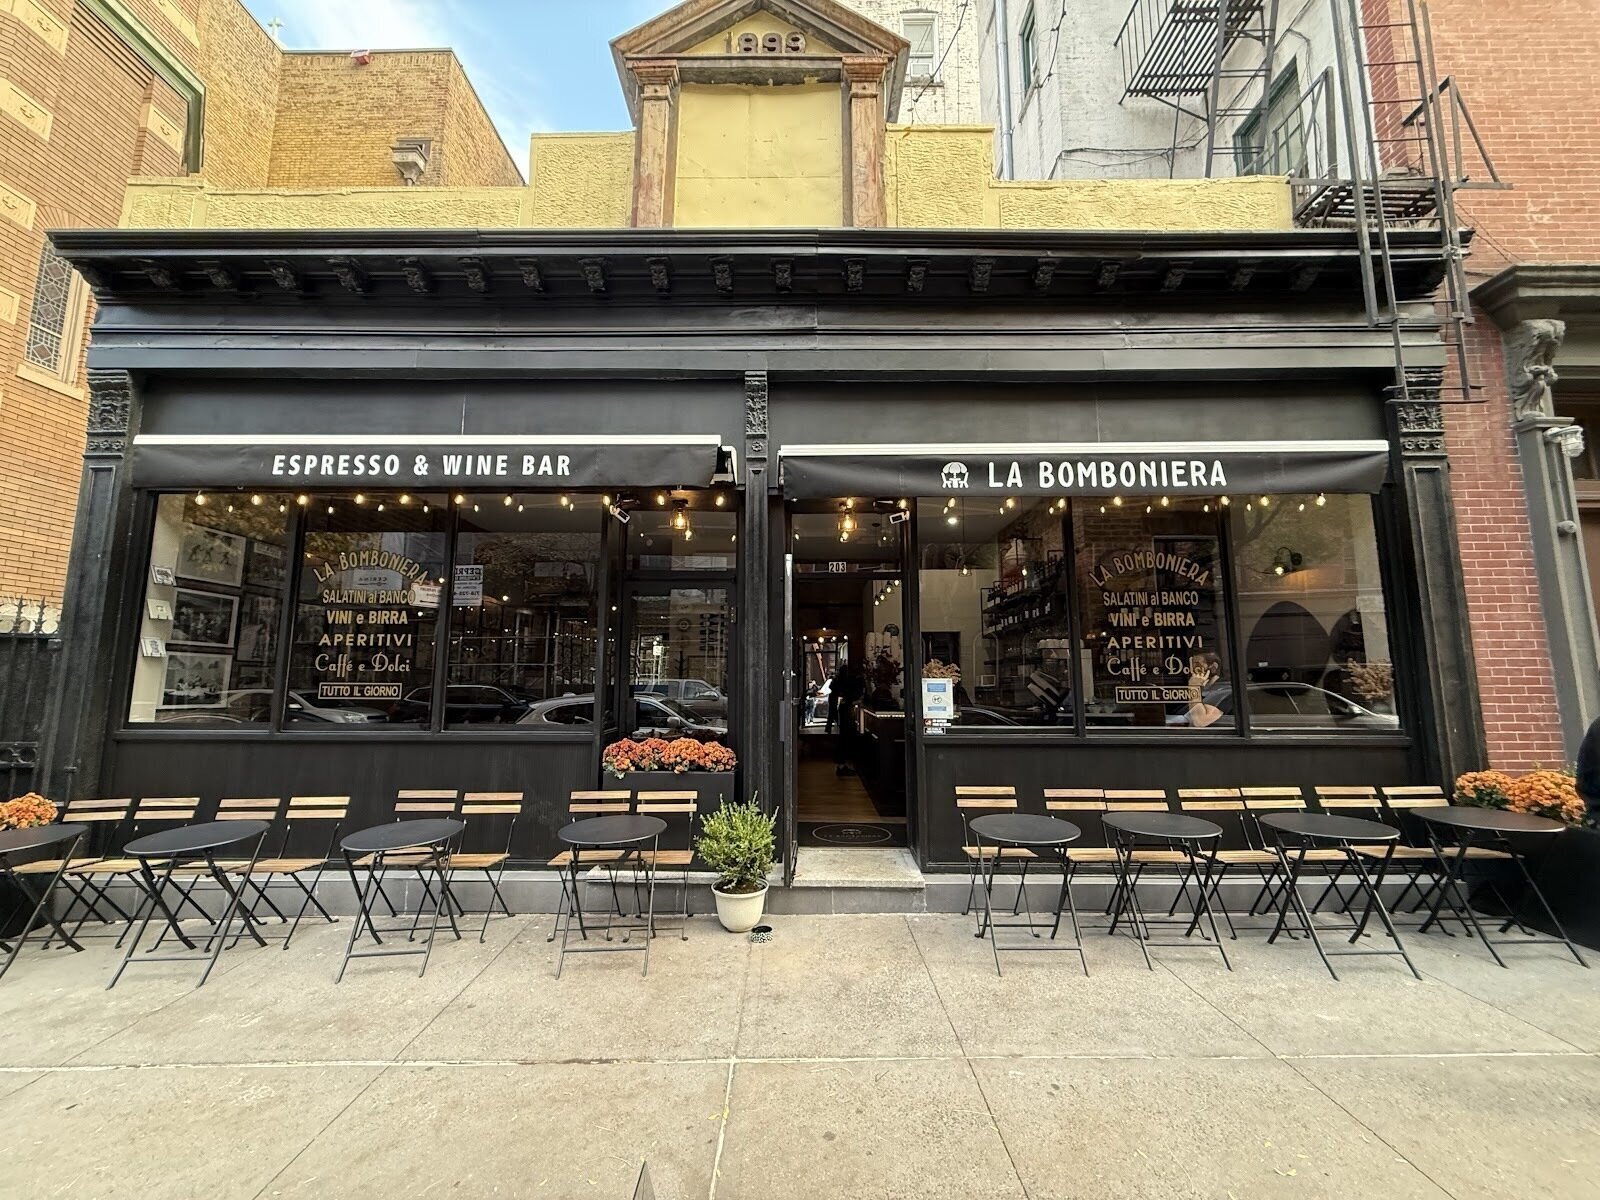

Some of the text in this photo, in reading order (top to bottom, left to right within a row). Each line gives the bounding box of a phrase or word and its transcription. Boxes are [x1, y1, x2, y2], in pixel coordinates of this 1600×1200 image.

[272, 454, 571, 476] ESPRESSO & WINE BAR
[988, 460, 1227, 488] LA BOMBONIERA
[313, 550, 428, 585] LA BOMBONIERA
[829, 562, 846, 573] 203
[1089, 551, 1209, 587] LA BOMBONIERA
[322, 589, 416, 605] SALATINI al BANCO
[1103, 591, 1199, 606] SALATINI al BANCO
[326, 610, 409, 625] VINI e BIRRA
[1110, 612, 1196, 627] VINI e BIRRA
[318, 633, 412, 647] APERITIVI
[1107, 635, 1203, 649] APERITIVI
[315, 651, 411, 678] Caffé e Dolci
[1107, 657, 1148, 682] Caffé
[1152, 666, 1160, 675] e
[321, 686, 399, 697] TUTTO IL GIORNO
[1118, 689, 1200, 700] TUTTO IL GIORNO
